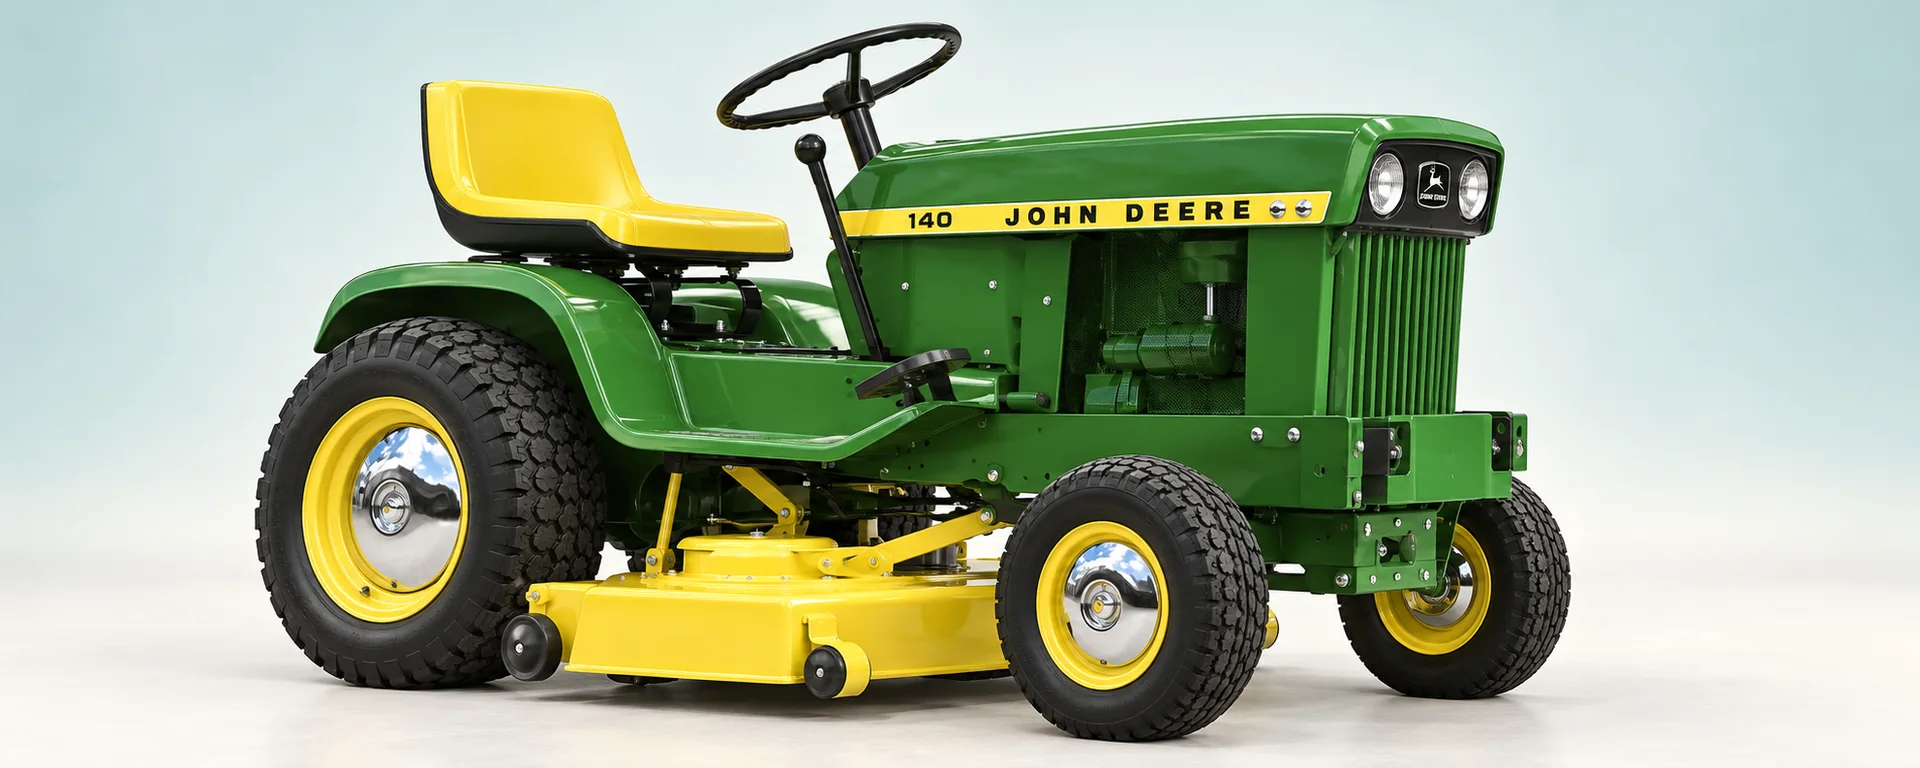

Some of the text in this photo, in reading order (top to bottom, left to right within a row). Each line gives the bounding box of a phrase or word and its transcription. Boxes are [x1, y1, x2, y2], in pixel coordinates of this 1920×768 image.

[908, 200, 1250, 229] 140 JOHN DEERE
